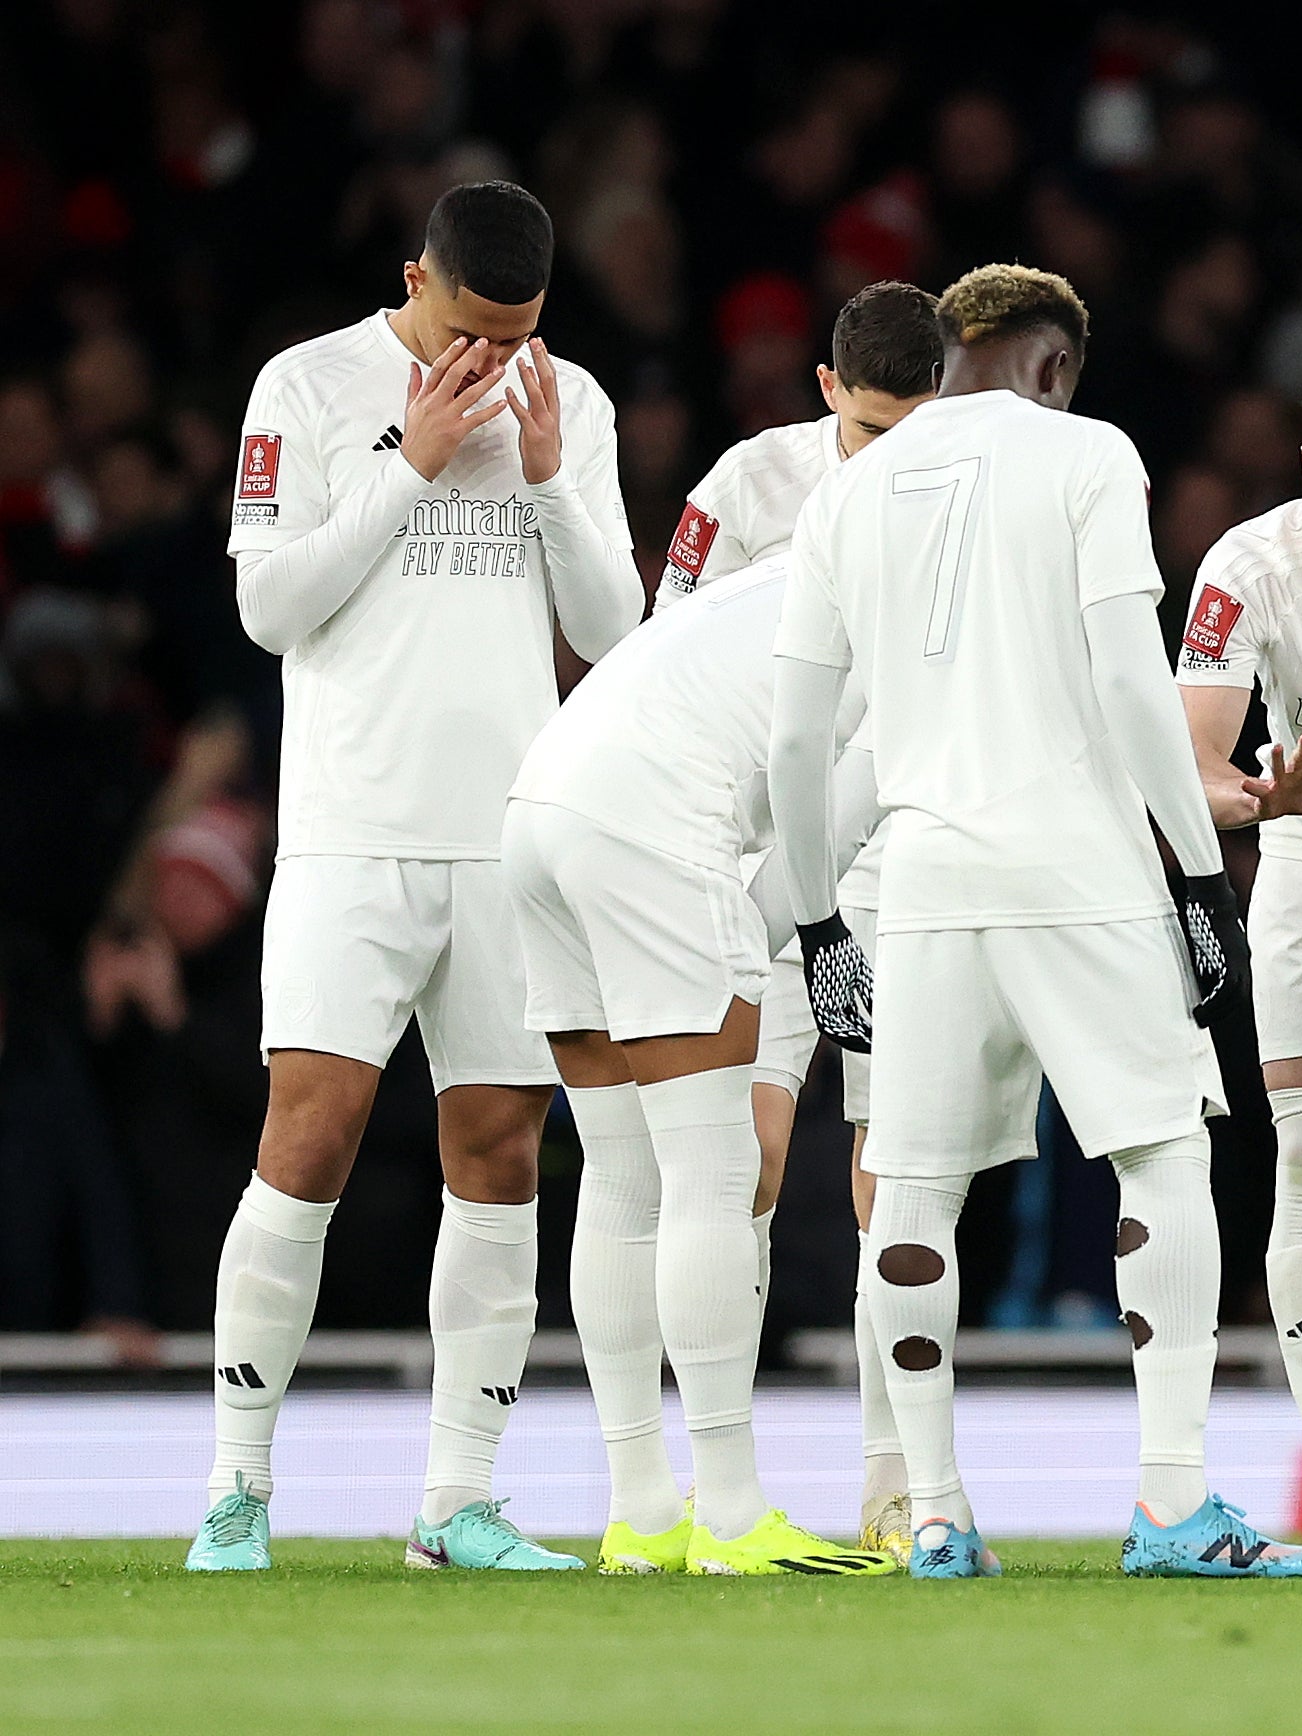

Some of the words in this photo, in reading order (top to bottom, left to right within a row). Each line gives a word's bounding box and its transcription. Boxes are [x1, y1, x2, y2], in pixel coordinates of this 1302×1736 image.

[243, 482, 252, 492] FA
[252, 482, 271, 492] CUP
[402, 541, 444, 577] FLY
[450, 541, 526, 578] BETTER
[681, 552, 699, 566] CUP
[891, 455, 983, 658] 7
[1198, 634, 1219, 648] CUP
